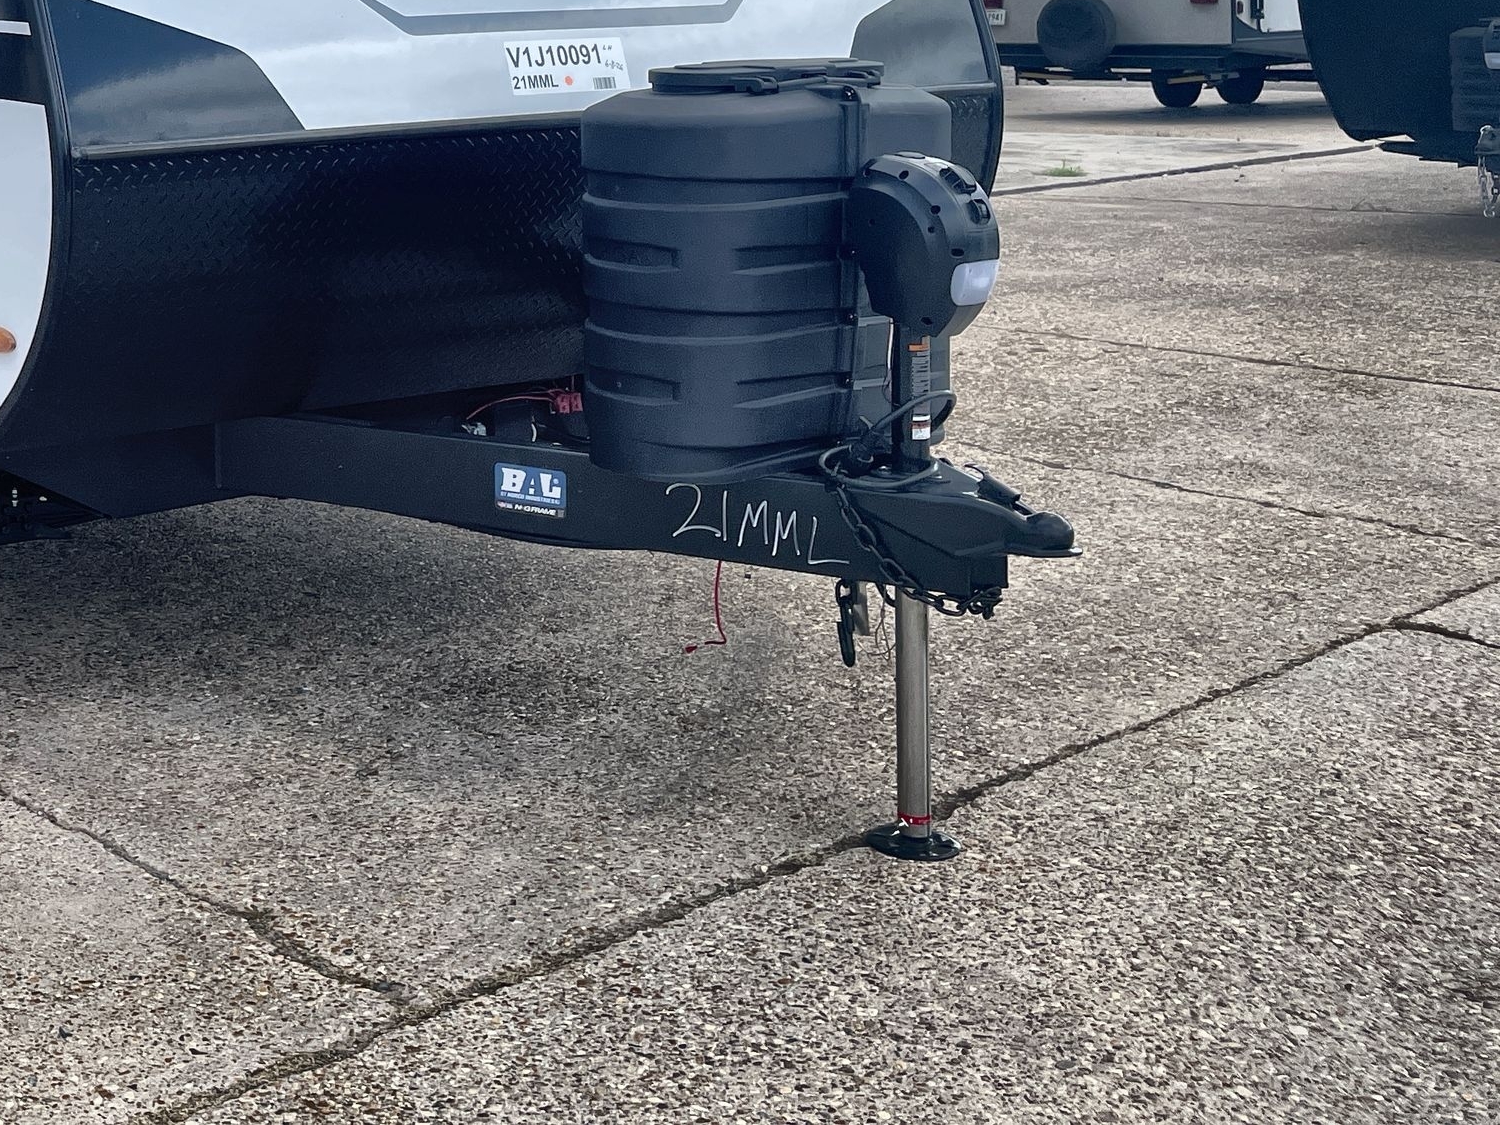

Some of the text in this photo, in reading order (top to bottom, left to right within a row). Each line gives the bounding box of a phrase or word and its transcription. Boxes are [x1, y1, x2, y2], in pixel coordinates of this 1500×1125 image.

[506, 43, 601, 68] V1J10091
[512, 74, 559, 90] 21MML
[501, 467, 561, 499] BAL
